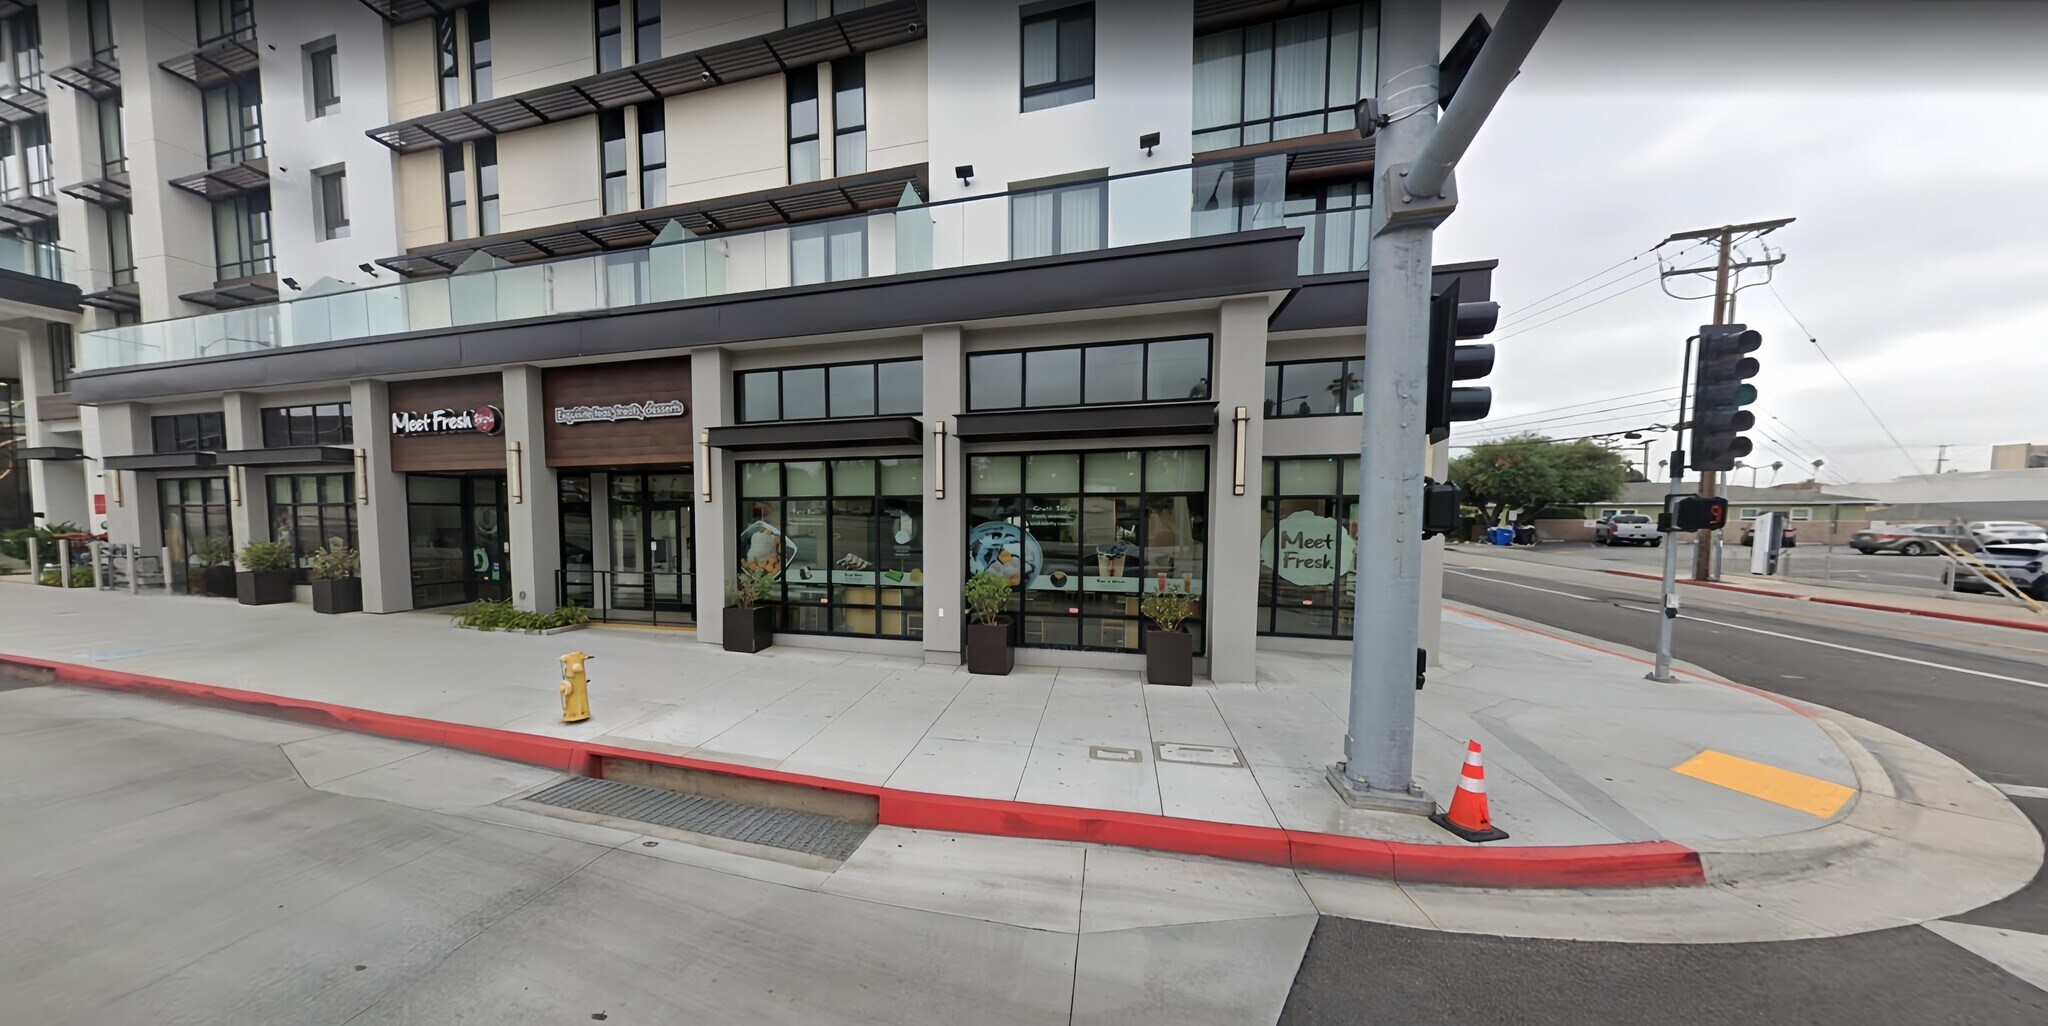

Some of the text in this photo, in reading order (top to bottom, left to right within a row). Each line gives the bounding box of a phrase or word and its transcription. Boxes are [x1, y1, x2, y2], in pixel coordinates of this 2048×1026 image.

[391, 412, 431, 434] Meet
[432, 409, 473, 431] Fresh
[1281, 530, 1335, 550] Meet
[1283, 552, 1334, 569] Fresh
